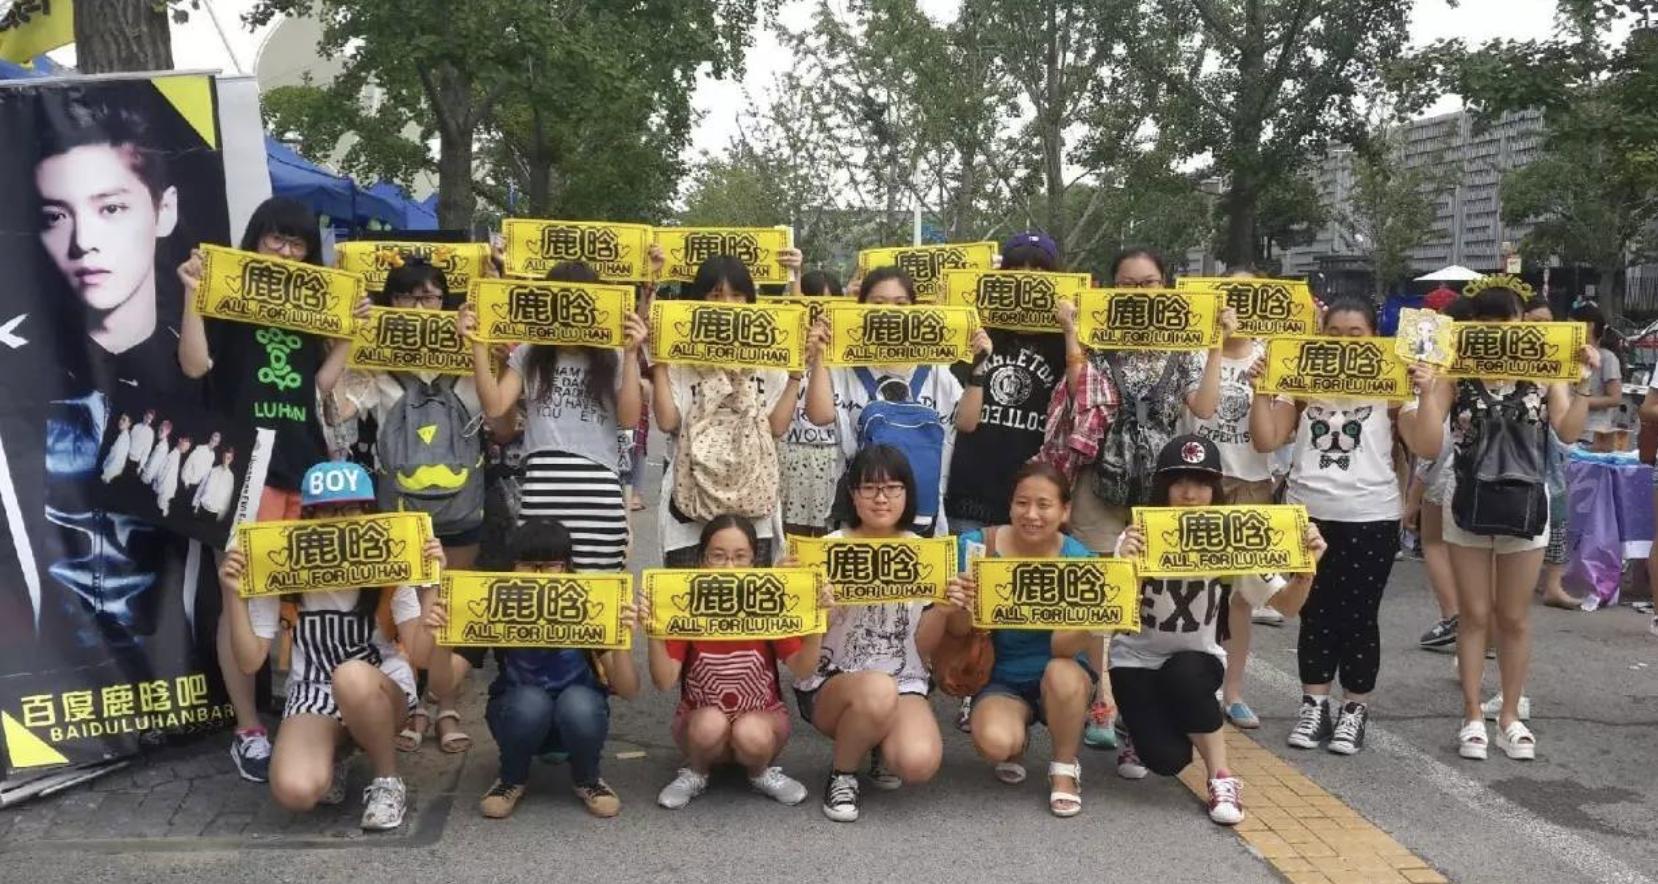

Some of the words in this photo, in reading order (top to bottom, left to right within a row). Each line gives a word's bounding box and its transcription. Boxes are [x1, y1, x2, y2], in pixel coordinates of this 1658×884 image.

[542, 226, 619, 260] 鹿晗
[245, 262, 328, 311] 鹿晗
[978, 275, 1055, 310] 鹿晗
[216, 297, 250, 313] ALL
[510, 286, 596, 327] 鹿晗
[1039, 312, 1058, 323] HA
[1109, 294, 1189, 330] 鹿晗
[379, 312, 461, 351] 鹿晗
[491, 323, 522, 336] ALL
[528, 326, 558, 338] FOR
[561, 328, 579, 340] LU
[583, 329, 609, 341] HAN
[691, 307, 775, 347] 鹿晗
[863, 310, 945, 345] 鹿晗
[1123, 331, 1150, 342] FOR
[1153, 331, 1171, 343] LU
[1174, 332, 1201, 343] HAN
[1460, 326, 1544, 359] 鹿晗
[671, 343, 700, 357] ALL
[706, 346, 734, 360] FOR
[739, 349, 757, 361] LU
[761, 350, 788, 362] HAN
[845, 346, 873, 359] ALL
[878, 347, 902, 360] FOR
[907, 347, 925, 359] LU
[930, 346, 956, 359] HAN
[1298, 342, 1382, 377] 鹿晗
[1475, 361, 1504, 372] FOR
[1509, 362, 1527, 373] LU
[1530, 362, 1559, 374] HAN
[1279, 377, 1307, 390] ALL
[1313, 379, 1340, 391] FOR
[1345, 380, 1363, 392] LU
[1368, 380, 1394, 392] HAN
[309, 468, 359, 495] BOY
[290, 522, 390, 569] 鹿晗
[1180, 512, 1270, 551] 鹿晗
[267, 571, 302, 588] ALL
[311, 569, 347, 584] FOR
[351, 566, 374, 581] LU
[377, 563, 410, 579] HAN
[829, 545, 918, 584] 鹿晗
[1161, 553, 1193, 567] ALL
[1199, 553, 1231, 566] FOR
[1235, 552, 1255, 566] LU
[1258, 551, 1288, 565] HAN
[489, 580, 587, 622] 鹿晗
[690, 576, 784, 615] 鹿晗
[845, 586, 876, 599] FOR
[881, 585, 899, 597] LU
[905, 584, 933, 596] HAN
[1013, 565, 1104, 604] 鹿晗
[464, 623, 499, 639] ALL
[506, 625, 541, 640] FOR
[546, 626, 567, 640] LU
[571, 626, 603, 640] HAN
[669, 618, 702, 632] ALL
[709, 618, 740, 632] FOR
[744, 618, 765, 632] LU
[769, 617, 800, 631] HAN
[993, 607, 1026, 621] ALL
[1031, 608, 1061, 621] FOR
[1065, 608, 1086, 621] LU
[1091, 608, 1120, 622] HAN
[20, 674, 208, 727] 百度鹿晗吧
[50, 703, 234, 741] BAIDULUHANBAR
